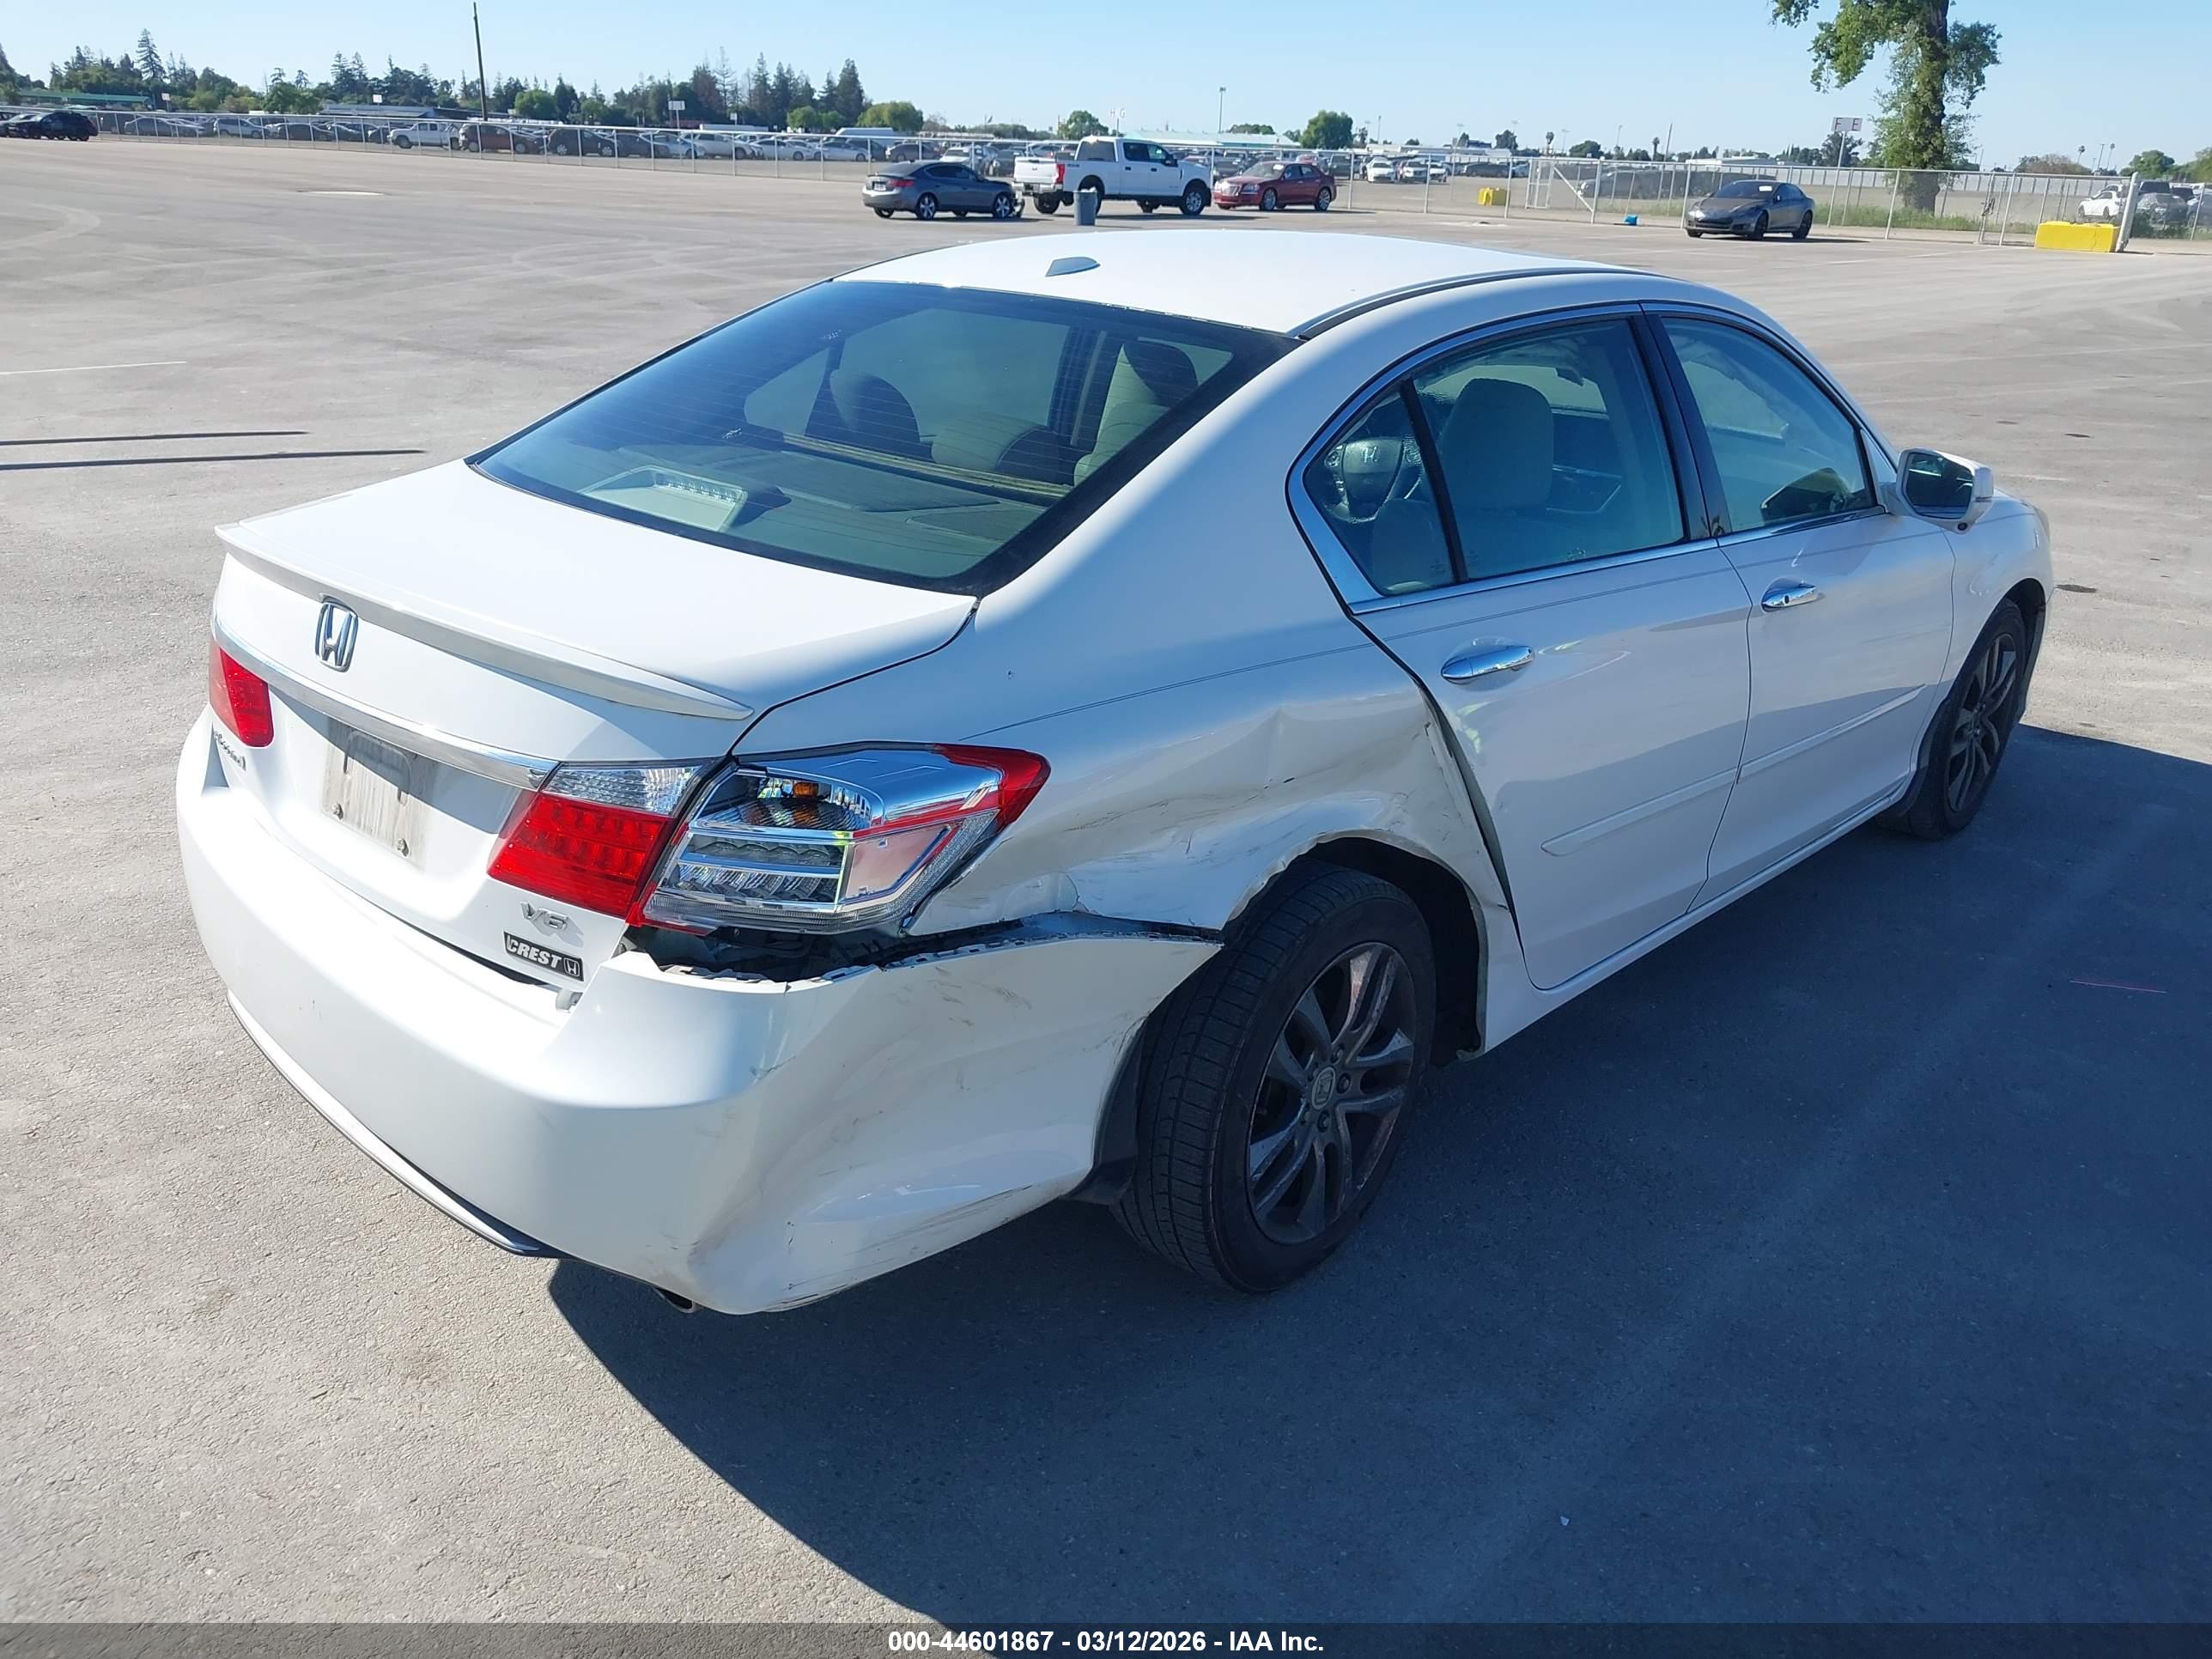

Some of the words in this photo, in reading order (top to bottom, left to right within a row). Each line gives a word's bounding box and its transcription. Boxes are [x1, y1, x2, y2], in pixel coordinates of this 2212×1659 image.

[1834, 117, 1844, 131] F
[1850, 118, 1861, 131] E
[520, 900, 568, 931] V6
[507, 934, 562, 969] CREST
